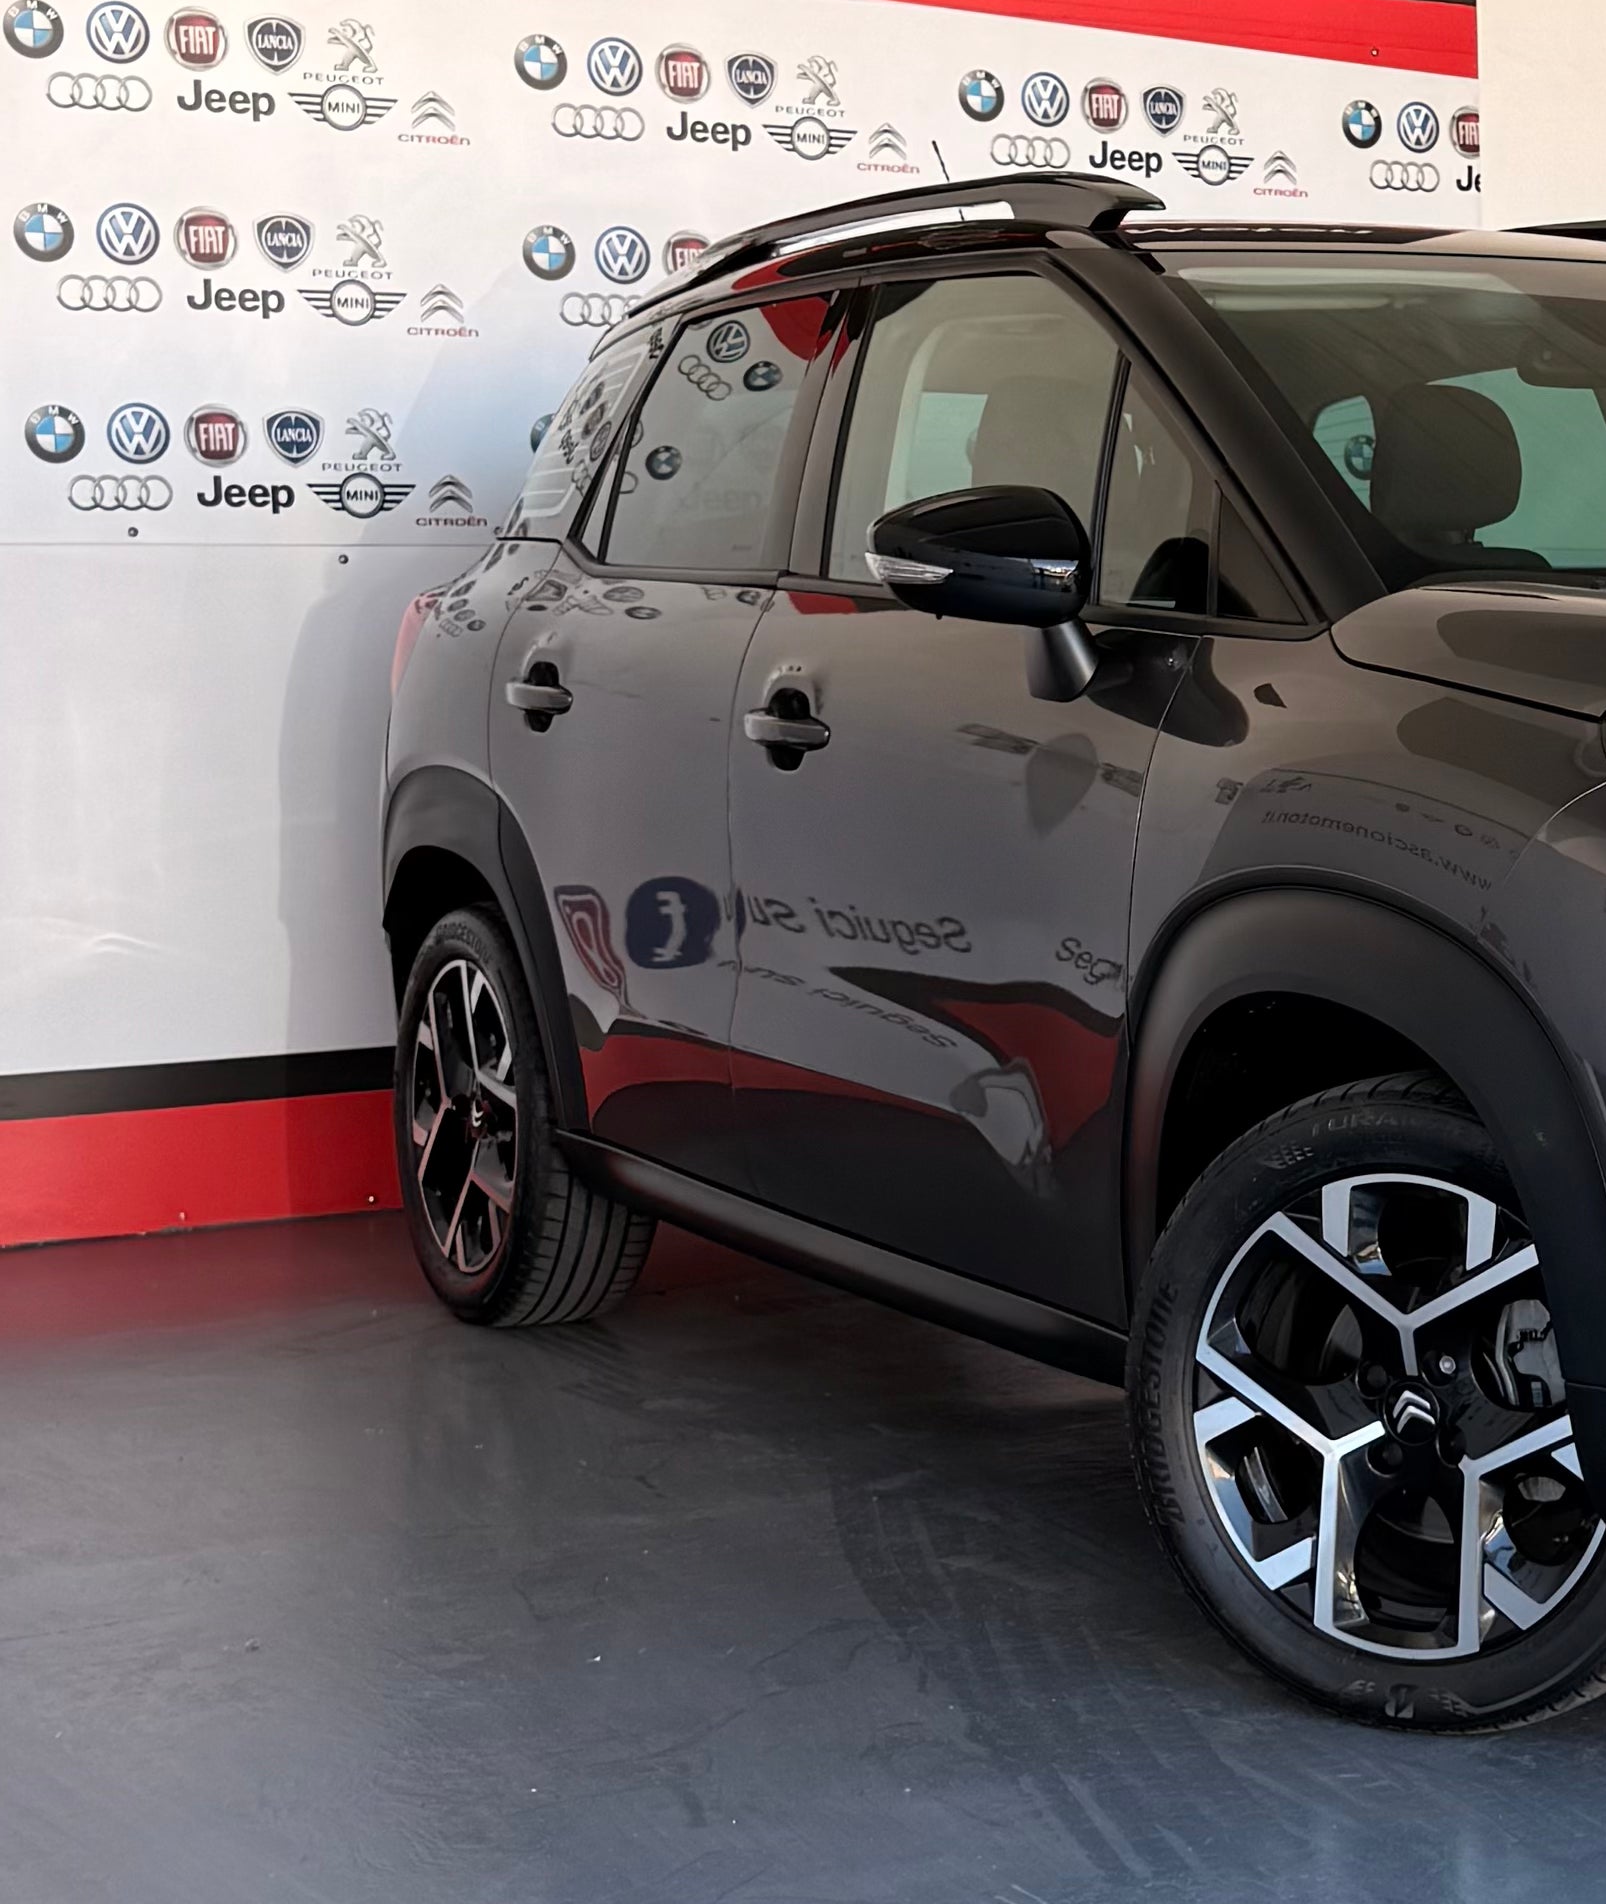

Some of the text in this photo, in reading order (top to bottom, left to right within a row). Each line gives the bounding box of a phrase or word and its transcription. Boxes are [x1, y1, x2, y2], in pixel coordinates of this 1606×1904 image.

[179, 25, 217, 55] FIAT
[303, 72, 384, 86] PEUGEOT
[669, 60, 699, 88] FIAT
[177, 79, 275, 122] Jeep
[328, 101, 360, 114] MINI
[775, 106, 845, 118] PEUGEOT
[1091, 94, 1120, 119] FIAT
[666, 111, 751, 152] Jeep
[797, 132, 825, 146] MINI
[1184, 134, 1245, 146] PEUGEOT
[1089, 141, 1163, 178] Jeep
[1202, 158, 1228, 172] MINI
[189, 225, 225, 254] FIAT
[312, 269, 394, 281] PEUGEOT
[187, 278, 286, 319] Jeep
[337, 296, 370, 310] MINI
[200, 423, 236, 452] FIAT
[322, 462, 403, 473] PEUGEOT
[197, 475, 295, 514] Jeep
[346, 489, 379, 502] MINI
[1136, 1279, 1186, 1526] BRIDGESTONE
